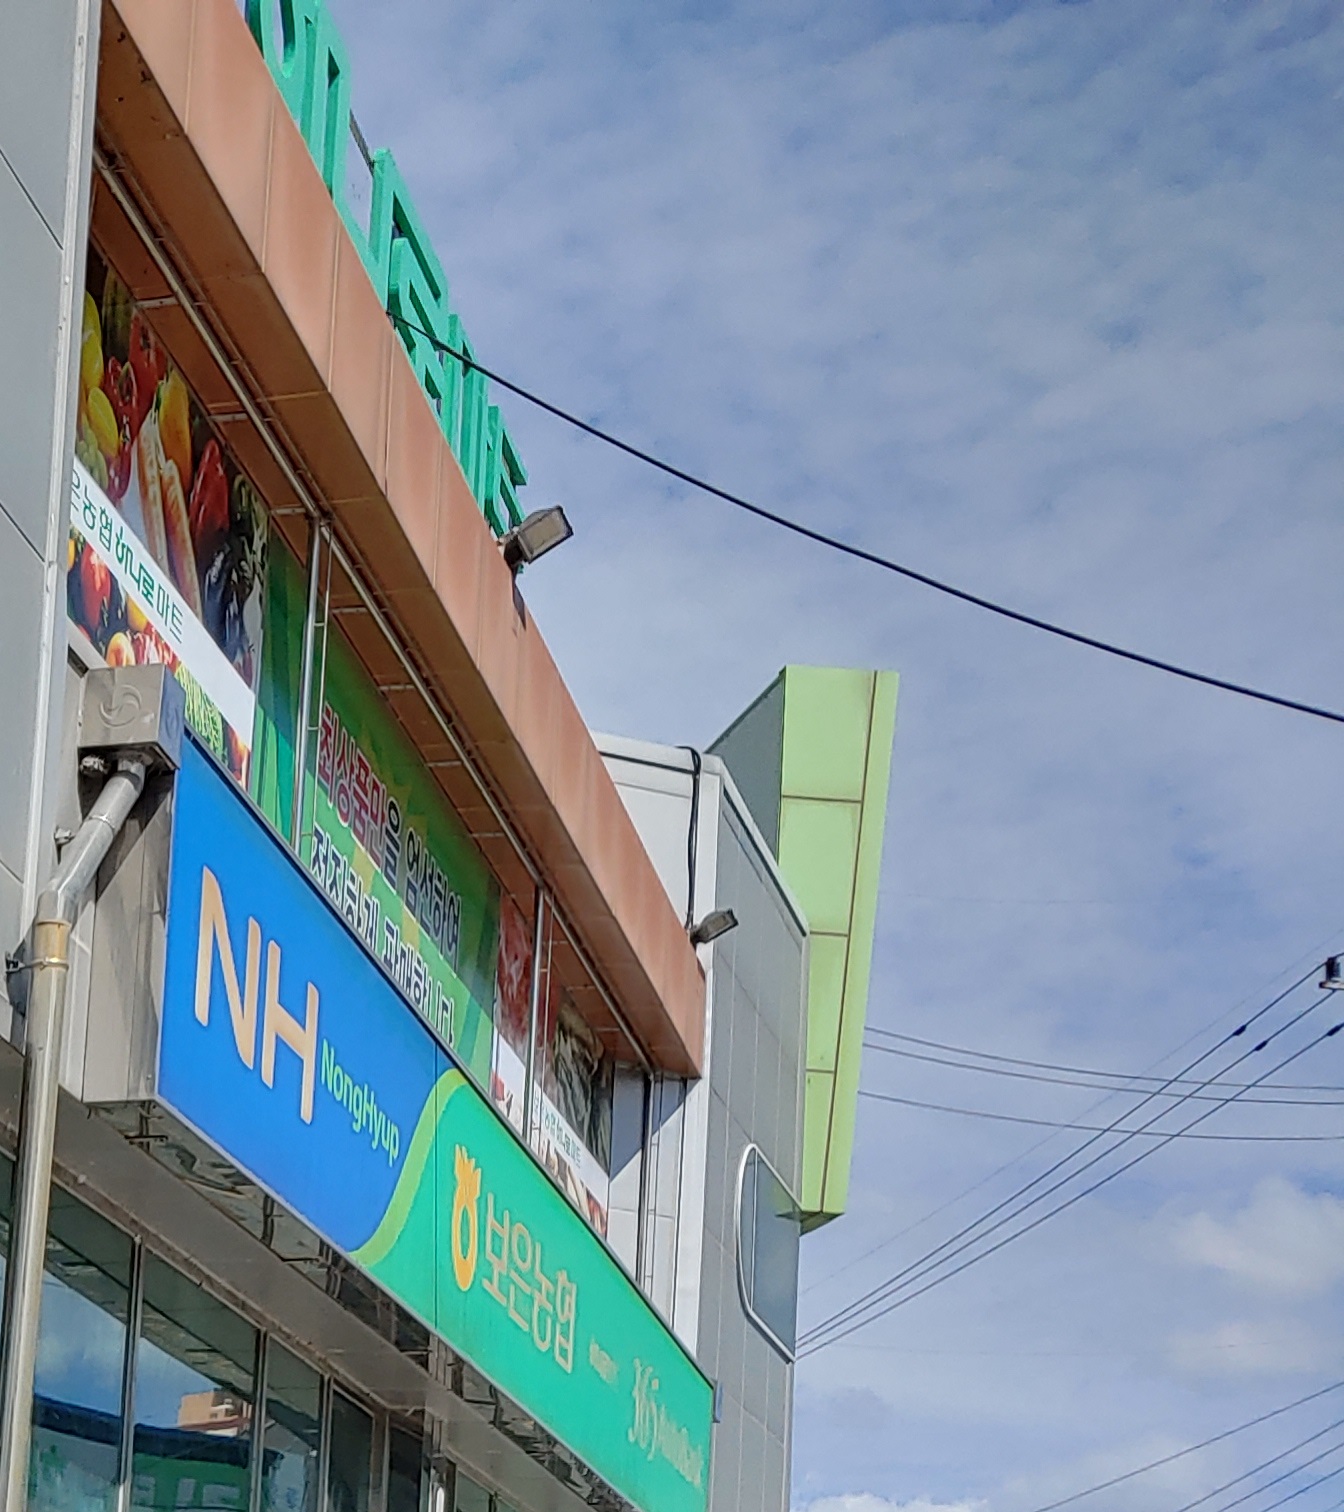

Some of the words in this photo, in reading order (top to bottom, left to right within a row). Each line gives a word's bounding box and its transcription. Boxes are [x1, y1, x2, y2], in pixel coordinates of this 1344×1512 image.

[194, 864, 320, 1126] NH
[320, 1042, 402, 1164] NongHyup
[482, 1191, 579, 1375] 보은농협
